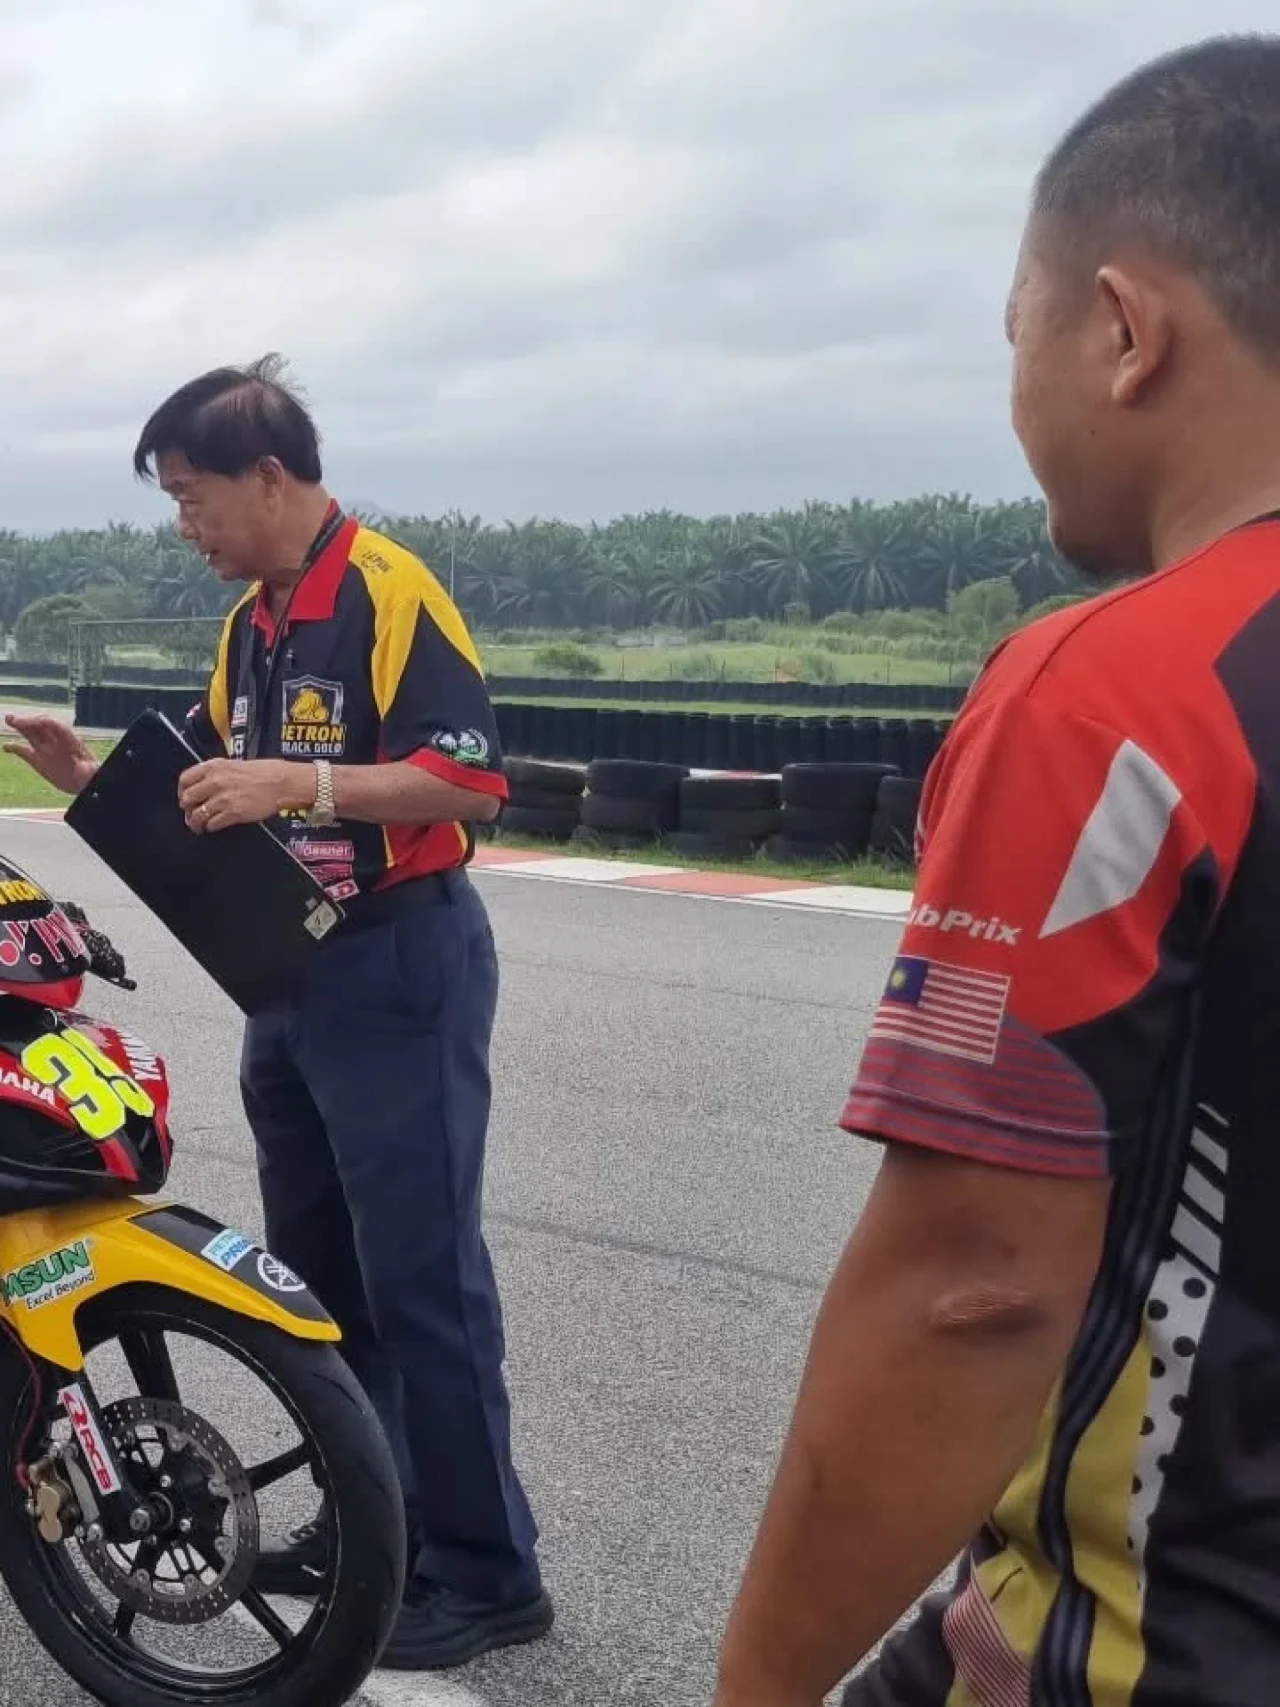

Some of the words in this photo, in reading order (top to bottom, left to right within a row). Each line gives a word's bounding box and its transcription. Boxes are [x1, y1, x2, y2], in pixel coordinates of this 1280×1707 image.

[314, 742, 342, 755] GOLD
[909, 903, 1023, 945] bPrix
[26, 1287, 54, 1309] Excel
[55, 1269, 95, 1296] Beyond
